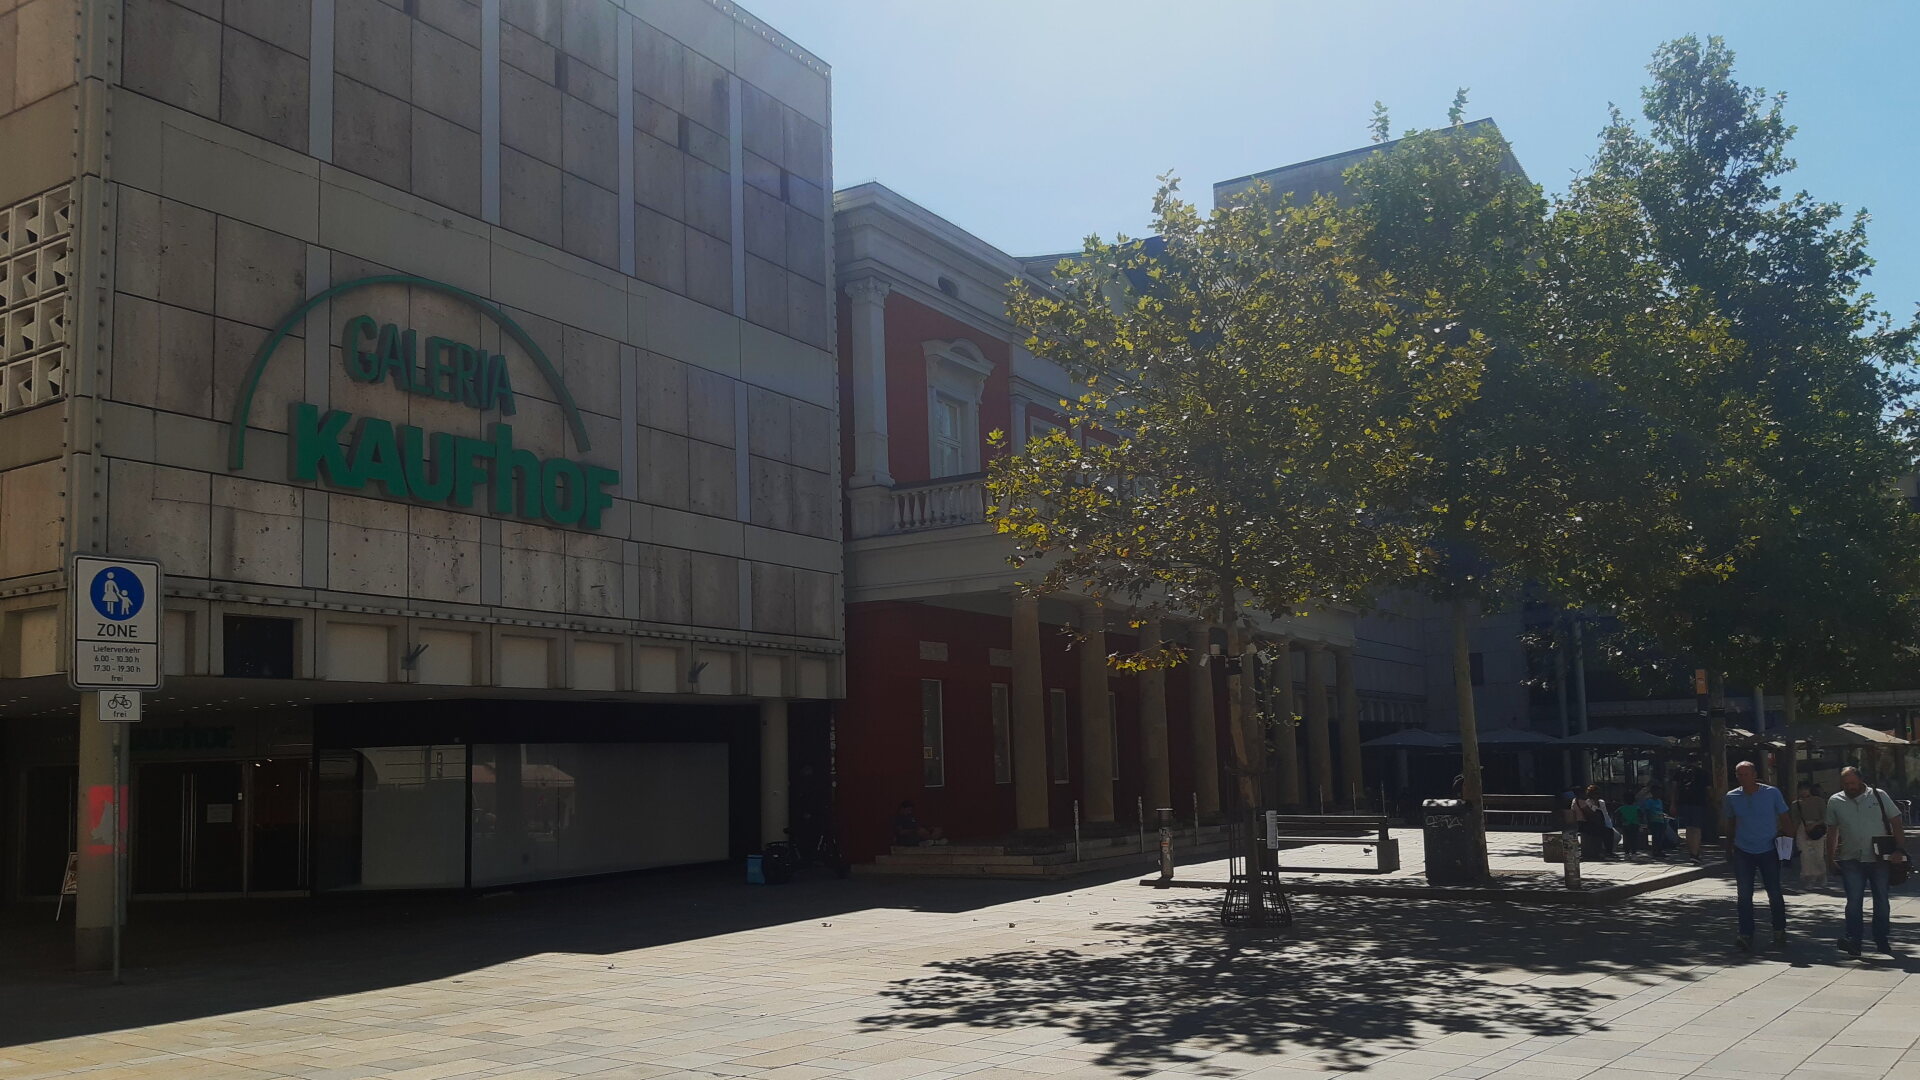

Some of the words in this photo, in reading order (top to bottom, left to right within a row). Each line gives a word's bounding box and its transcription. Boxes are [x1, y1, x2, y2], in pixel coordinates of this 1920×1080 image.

[342, 315, 516, 416] GALERIA
[97, 623, 138, 637] ZONE
[93, 645, 141, 654] Lieferverkehr
